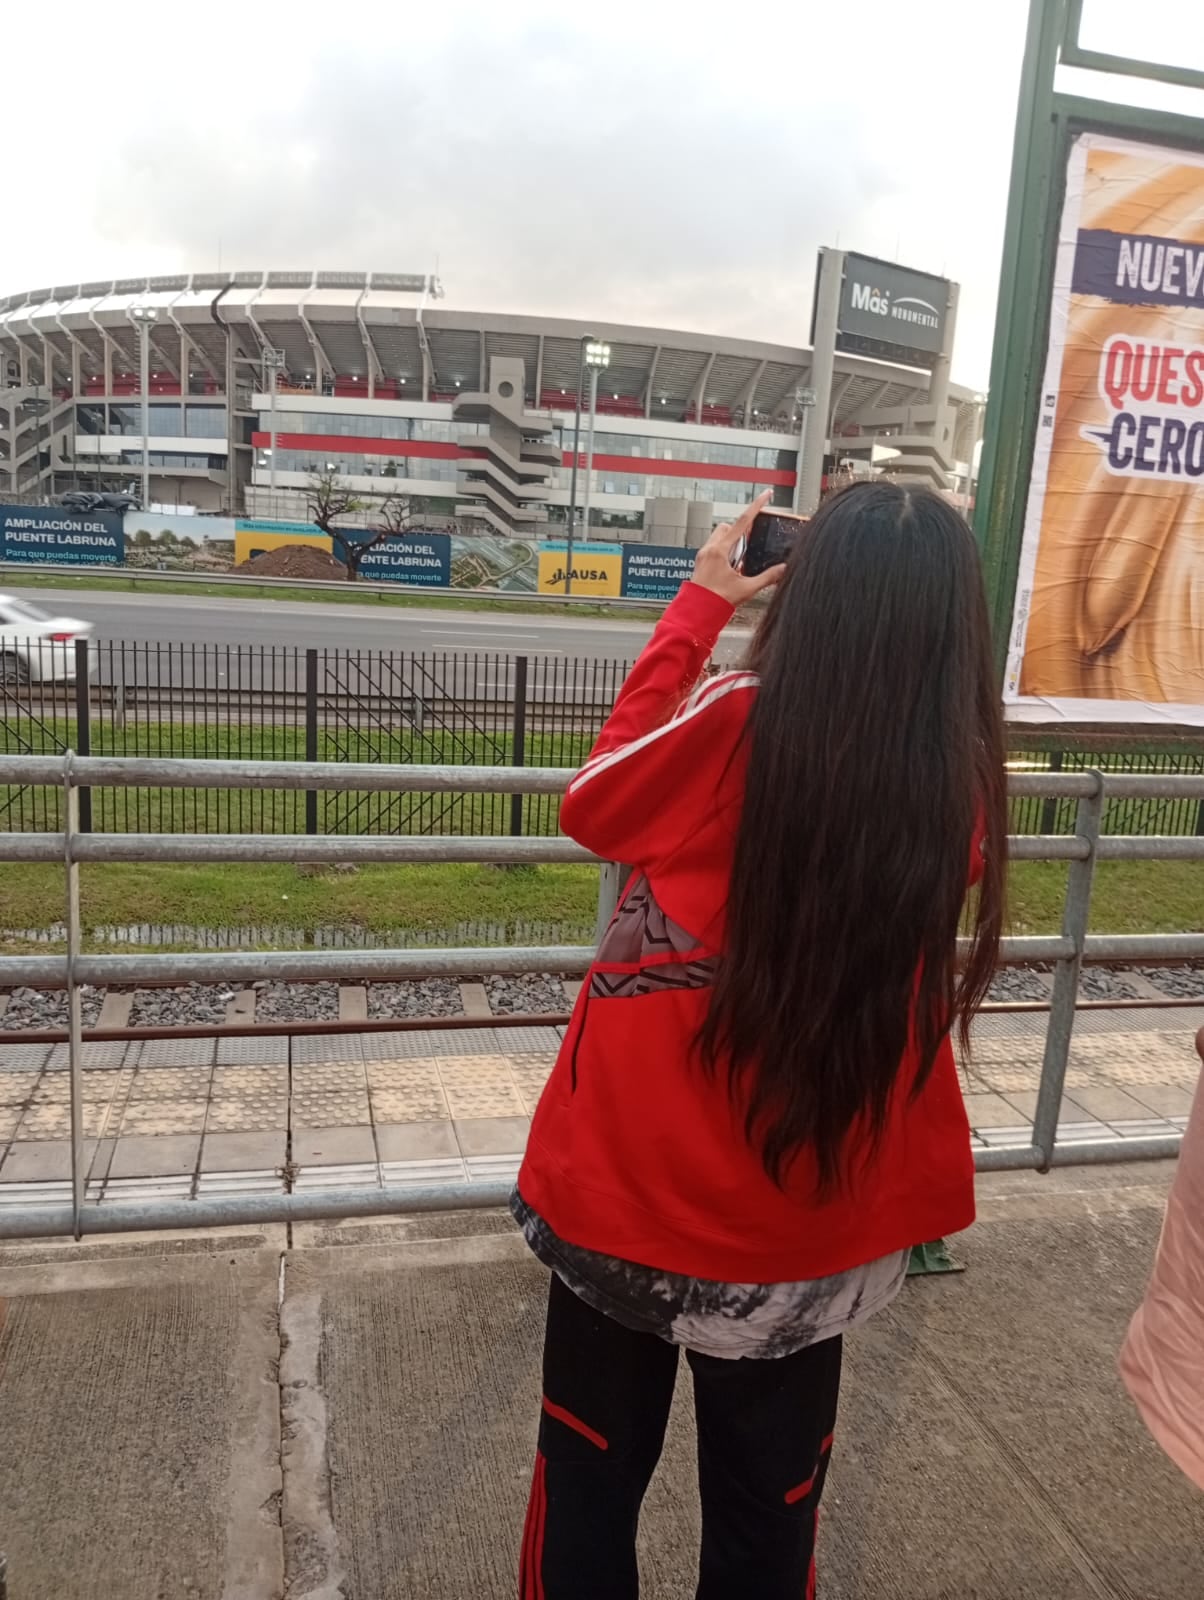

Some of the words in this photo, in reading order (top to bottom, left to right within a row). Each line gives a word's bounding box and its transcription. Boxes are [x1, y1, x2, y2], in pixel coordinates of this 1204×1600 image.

[1116, 239, 1204, 298] NUEV
[891, 306, 938, 328] MONUMENTAL
[5, 518, 81, 531] AMPLIACIÓN
[84, 522, 108, 533] DEL
[5, 532, 55, 543] PUENTE
[57, 535, 117, 547] LABRUNA
[6, 549, 27, 557] Para
[28, 551, 45, 559] que
[46, 552, 79, 560] puedas
[80, 554, 117, 562] moverte
[414, 545, 435, 555] DEL
[354, 554, 389, 565] ENTE
[391, 556, 442, 567] LABRUNA
[629, 555, 687, 567] AMPLIACIÓN
[381, 572, 409, 580] puedas
[628, 567, 666, 578] PUENTE
[667, 570, 694, 580] LABR
[657, 582, 680, 592] pueda
